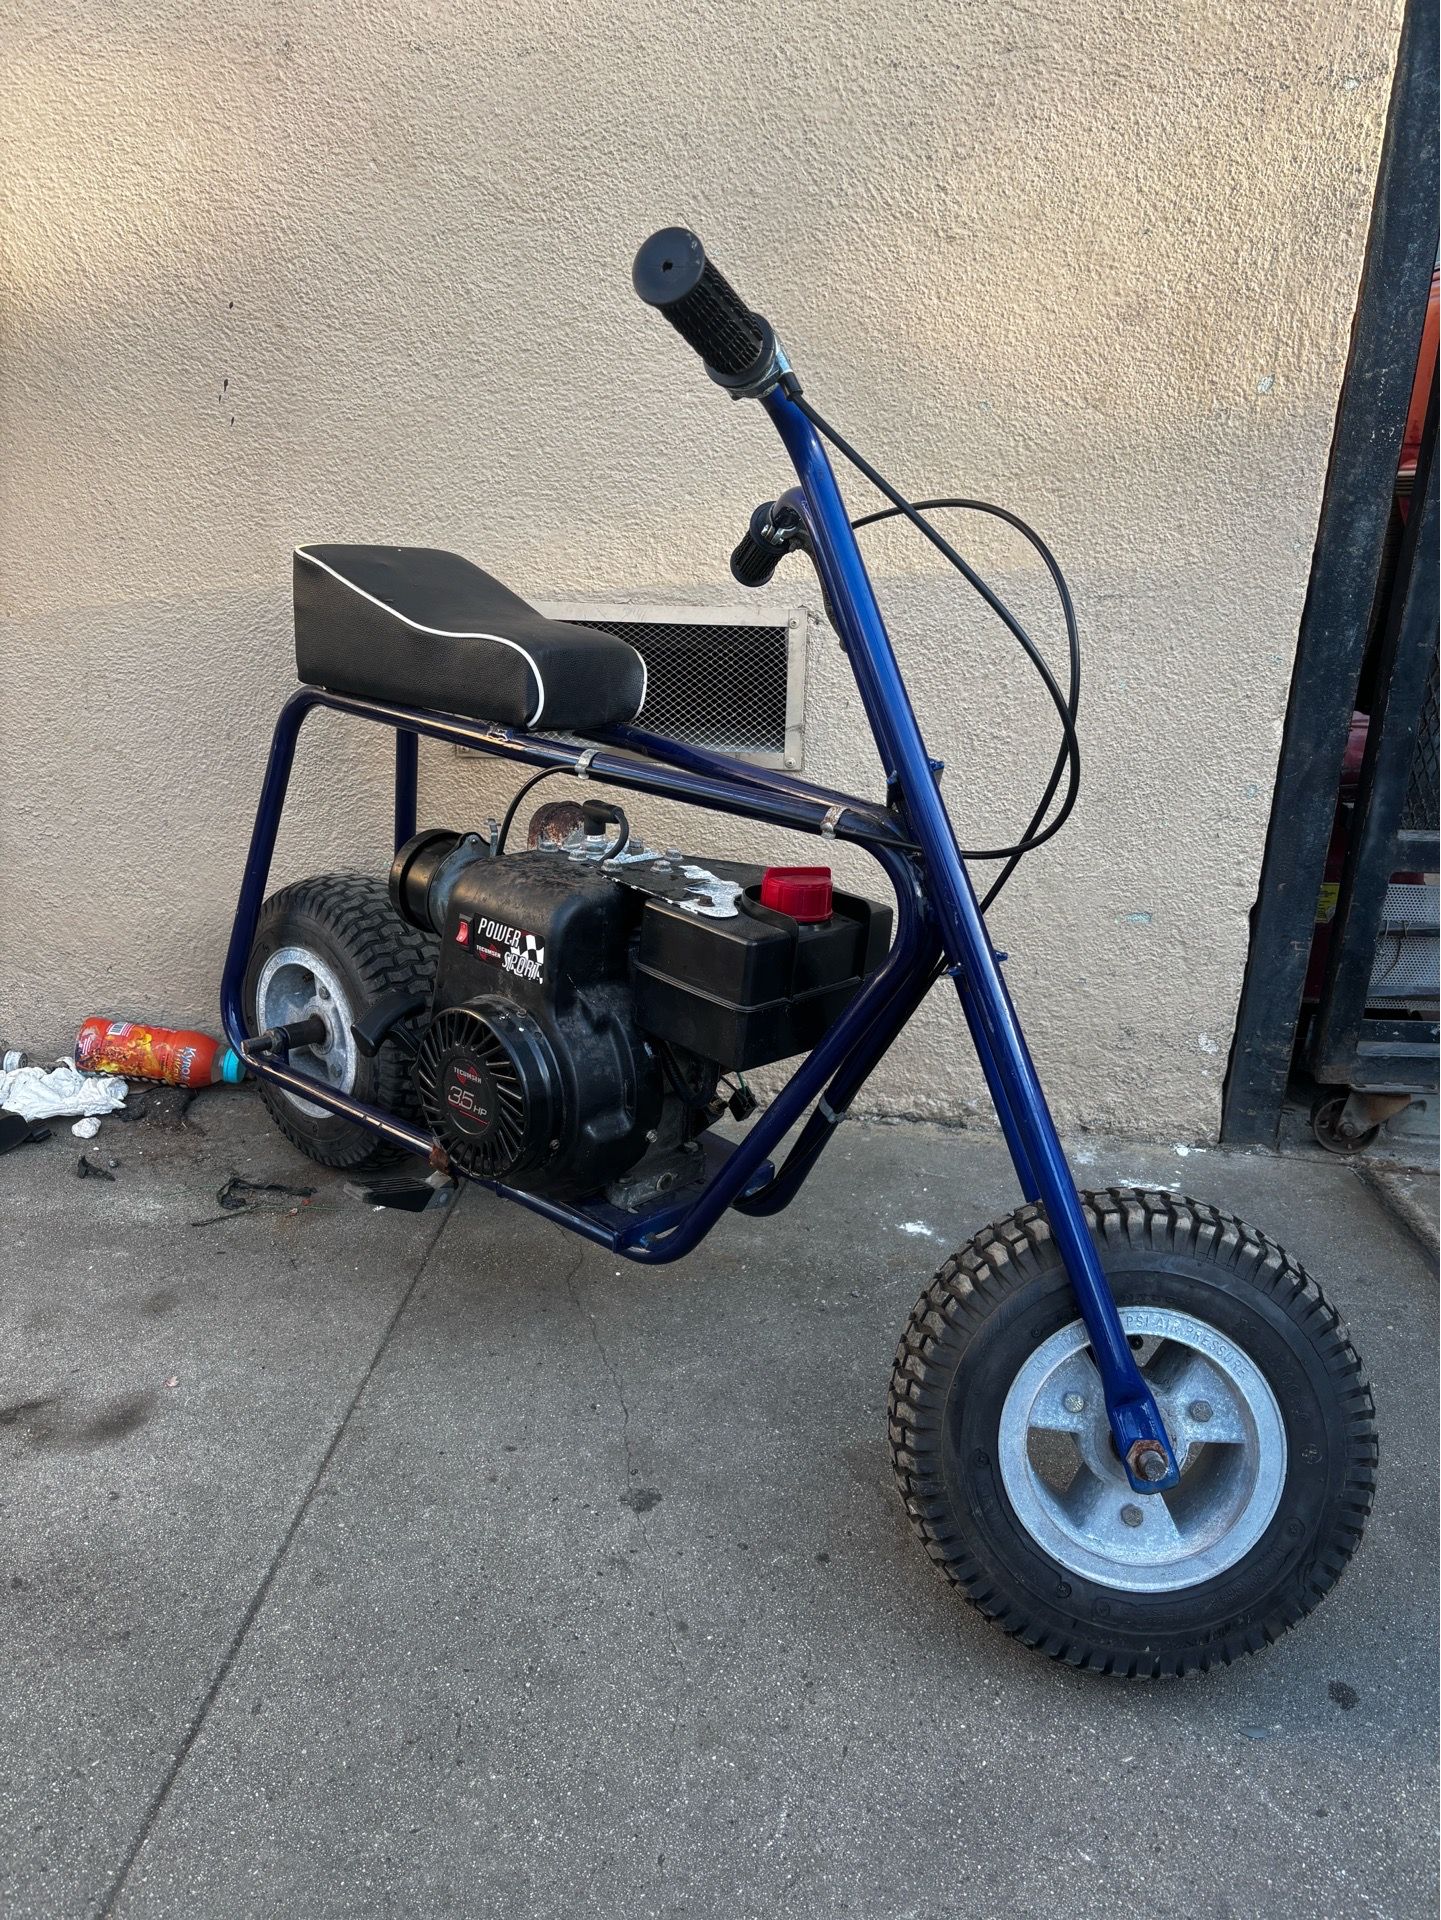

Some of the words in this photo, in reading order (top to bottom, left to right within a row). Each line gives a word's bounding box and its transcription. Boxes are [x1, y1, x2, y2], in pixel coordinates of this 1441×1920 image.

[478, 917, 522, 948] POWER
[502, 951, 543, 981] SPORT
[473, 1104, 488, 1116] HP
[1125, 1314, 1150, 1329] PSI
[1155, 1316, 1181, 1334] AIR
[1187, 1325, 1250, 1379] PRESSURE
